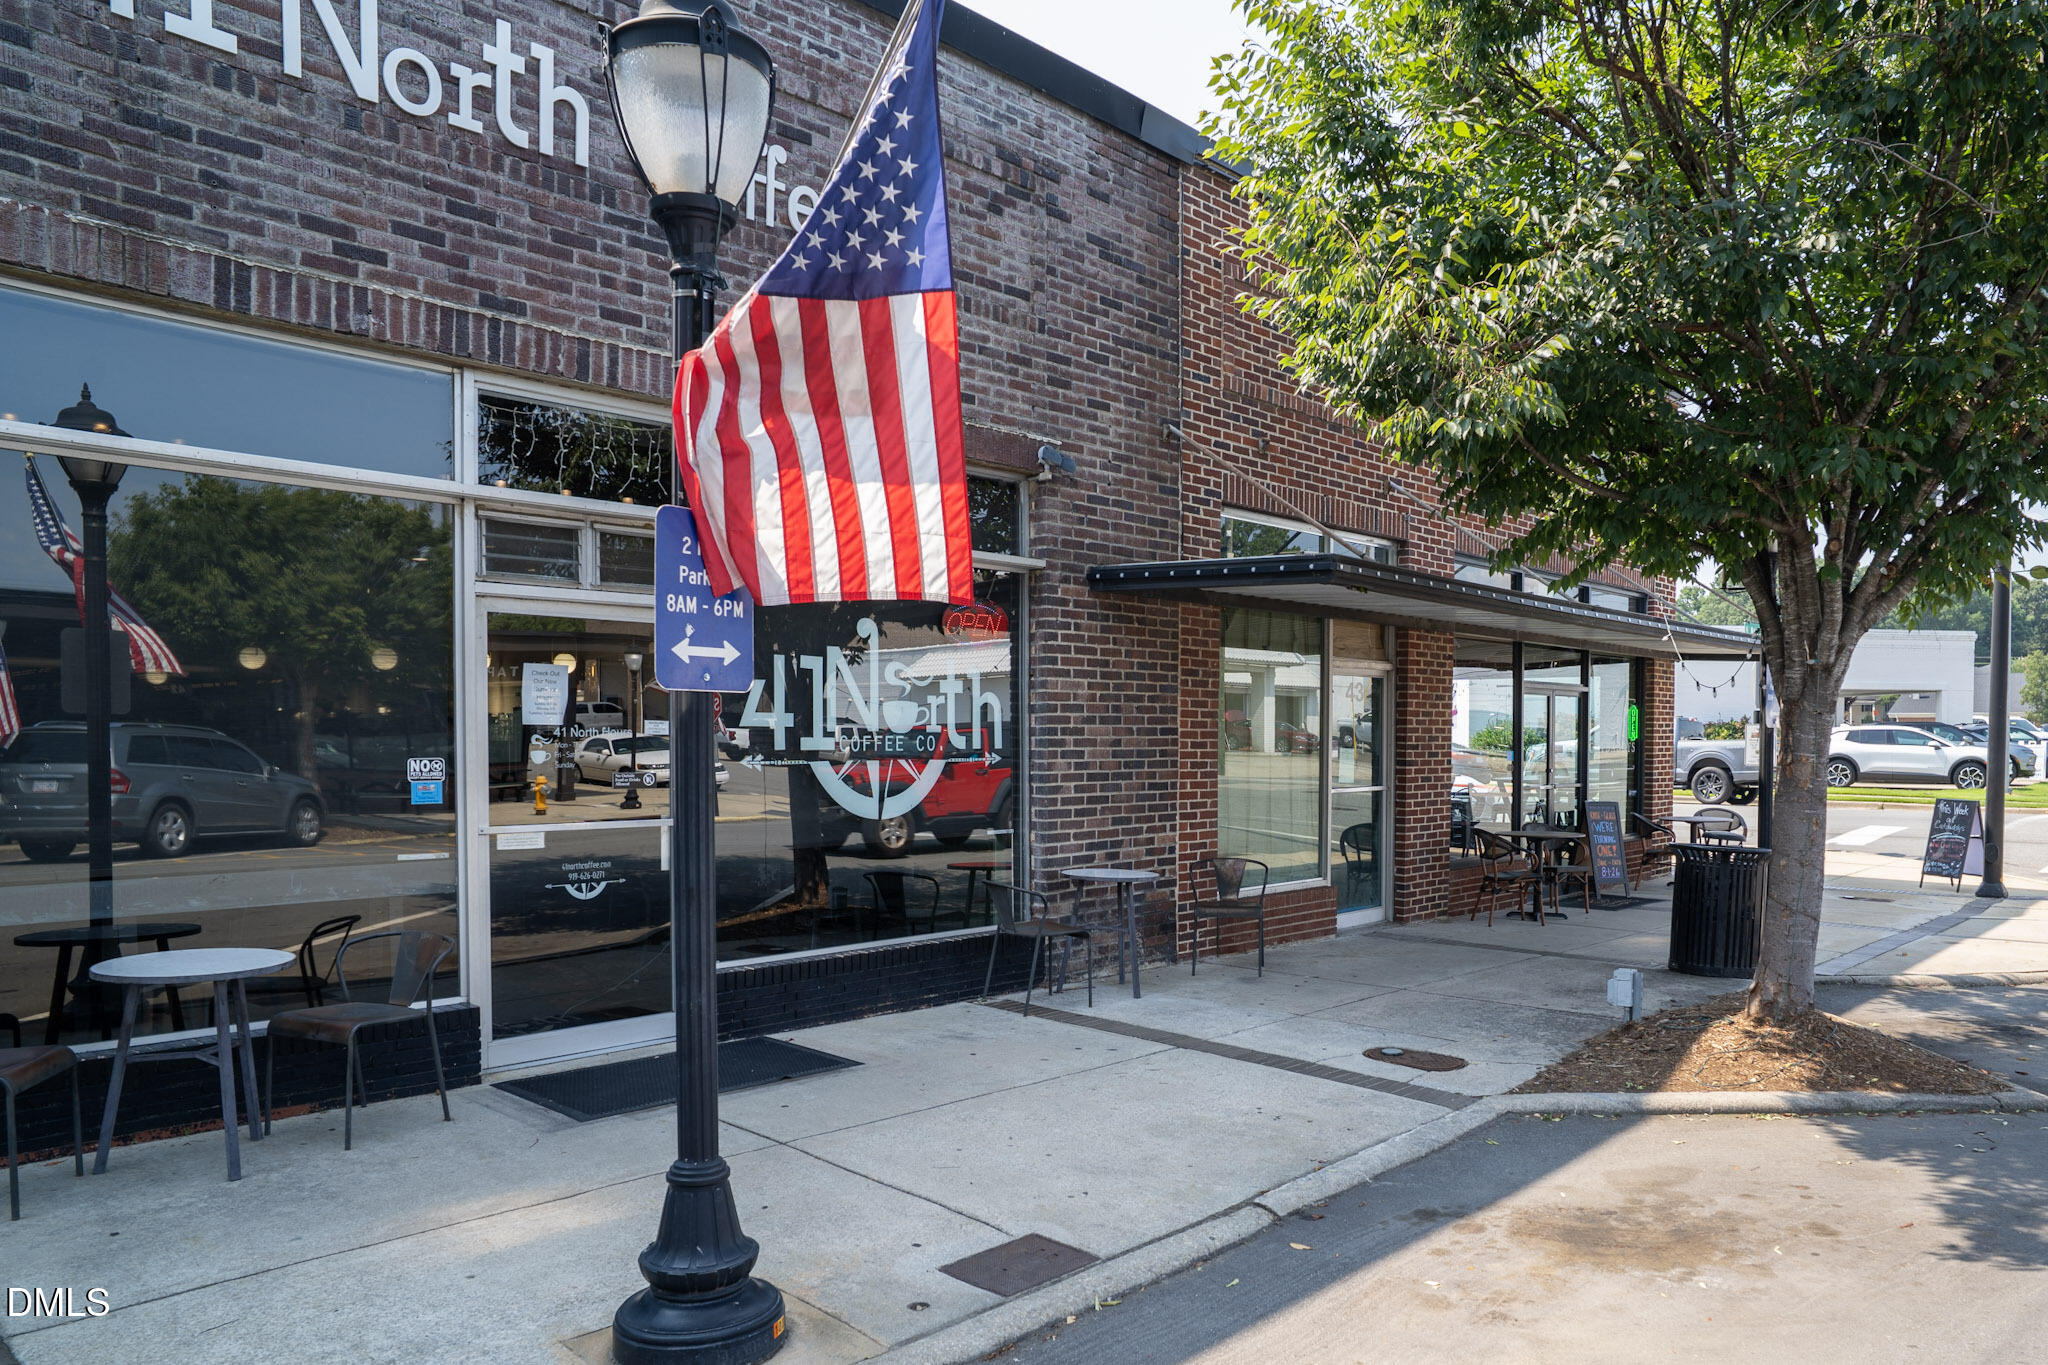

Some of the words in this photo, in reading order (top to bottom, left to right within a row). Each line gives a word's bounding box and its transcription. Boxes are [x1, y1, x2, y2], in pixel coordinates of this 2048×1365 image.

[282, 0, 590, 167] North
[682, 536, 692, 555] 2
[679, 565, 711, 586] Park
[666, 593, 697, 614] 8AM
[713, 599, 744, 618] 6PM
[946, 612, 1002, 638] OPEN
[553, 727, 567, 738] 41
[570, 724, 599, 738] North
[840, 735, 904, 752] COFFEE
[410, 760, 430, 772] NO
[554, 761, 576, 769] Sunday
